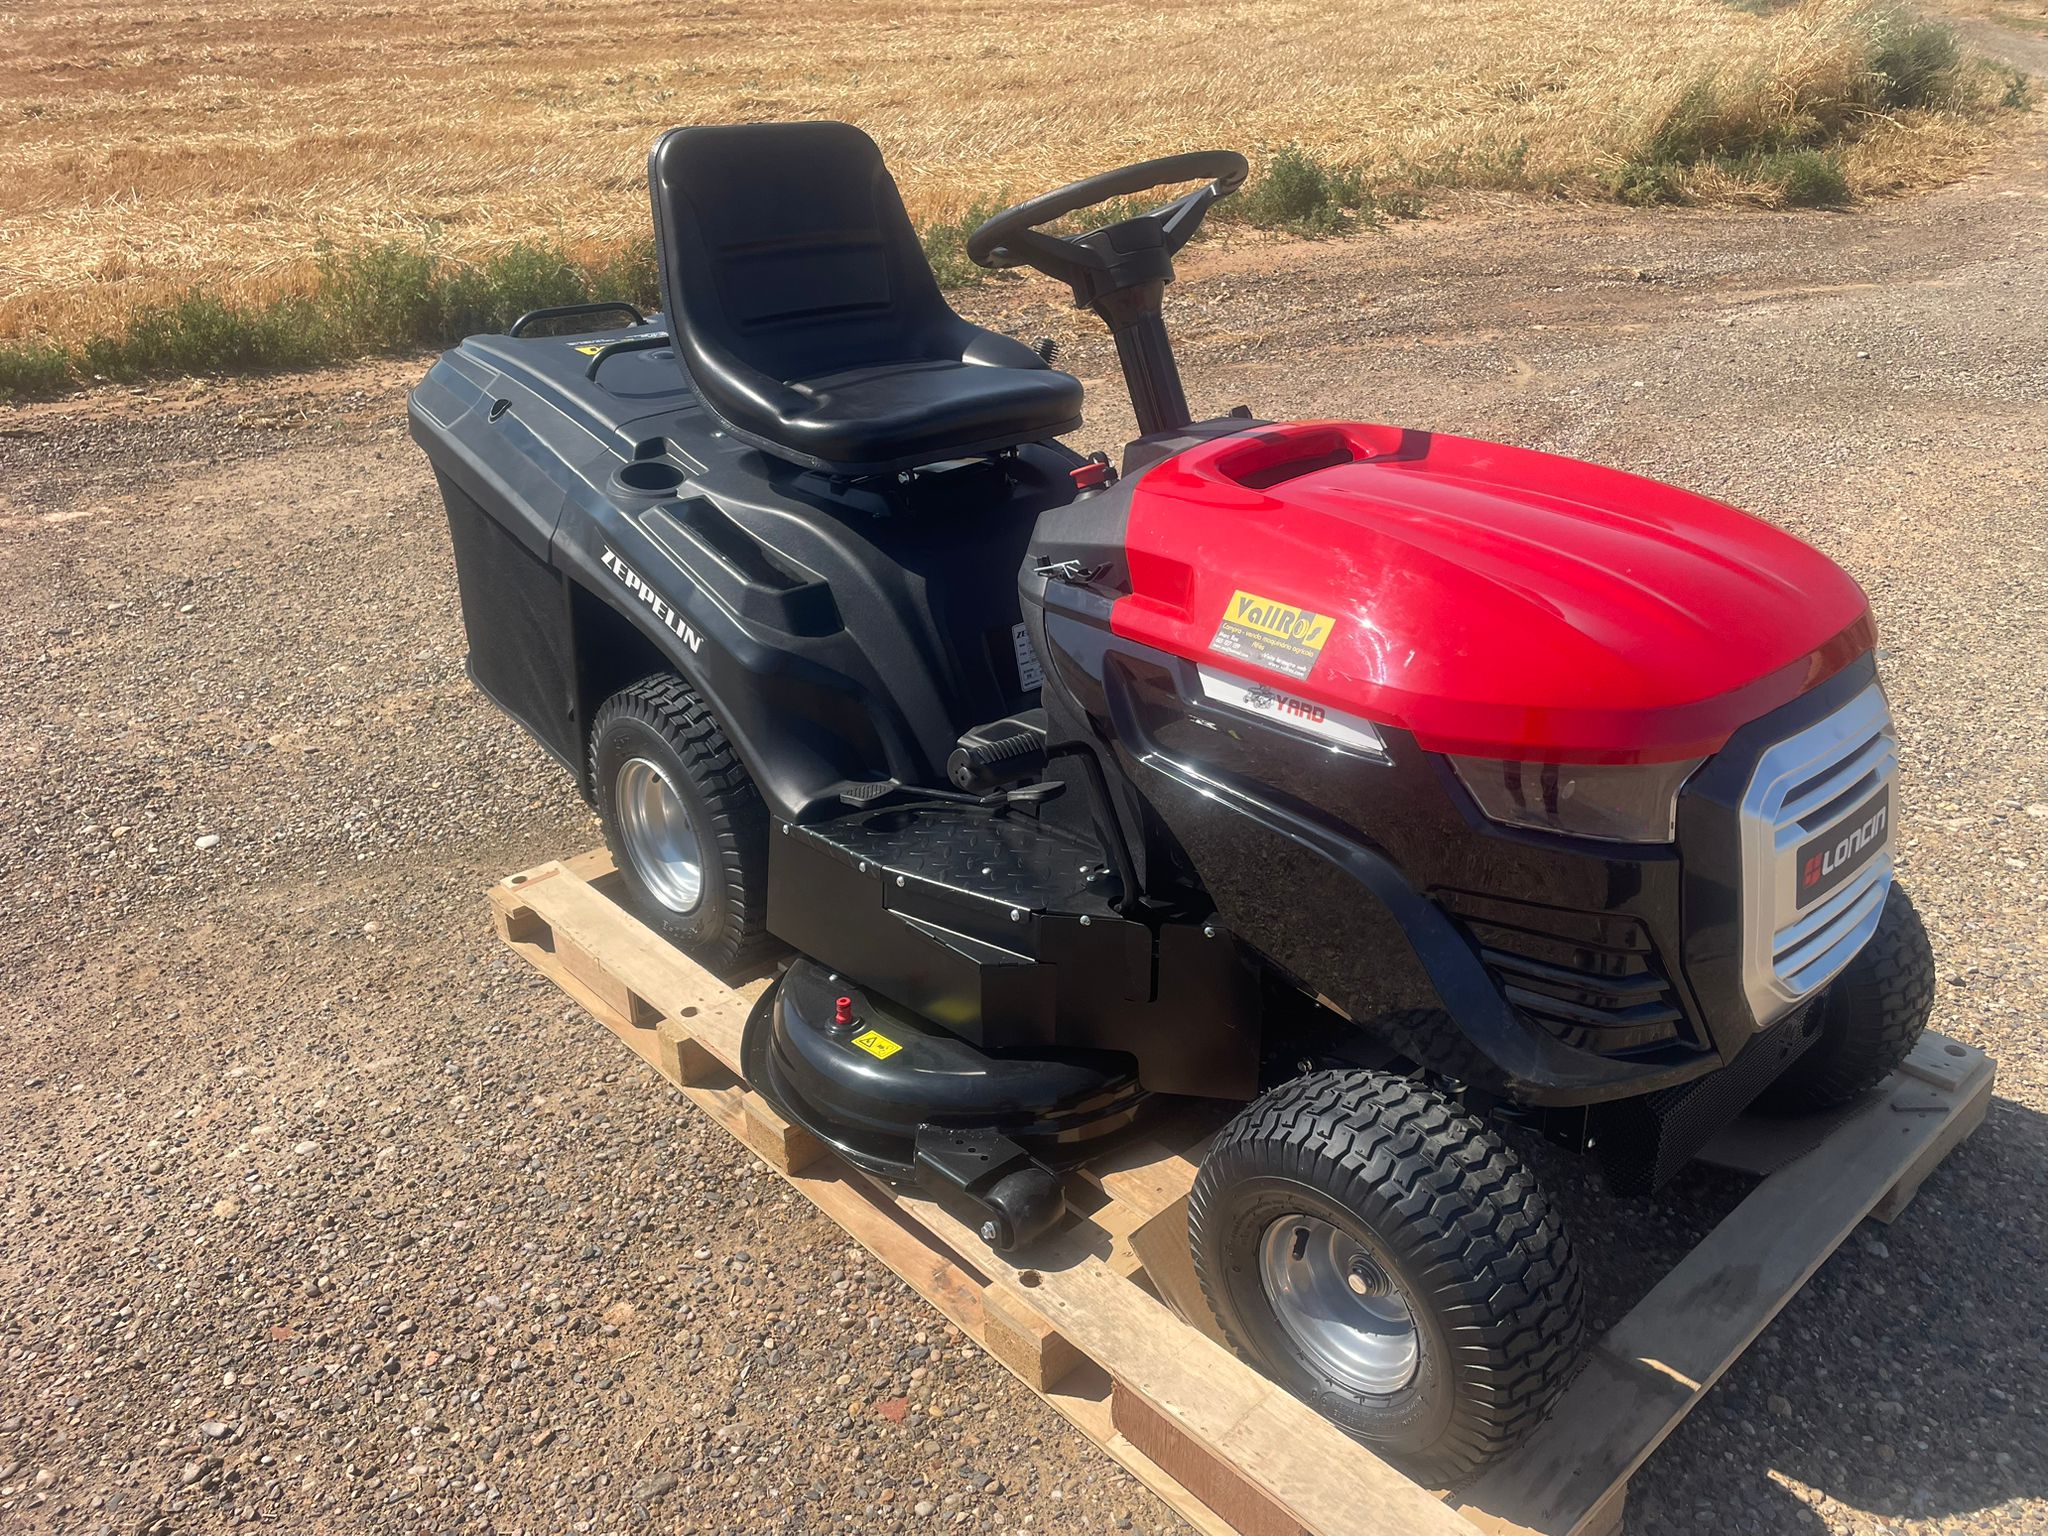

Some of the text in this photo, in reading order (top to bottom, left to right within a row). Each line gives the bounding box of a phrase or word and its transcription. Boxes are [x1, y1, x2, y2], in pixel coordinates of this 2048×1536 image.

[600, 544, 702, 654] ZEPPELIN
[1222, 622, 1242, 635] Compra
[1275, 694, 1327, 724] YARD
[1821, 805, 1887, 876] LONCIN
